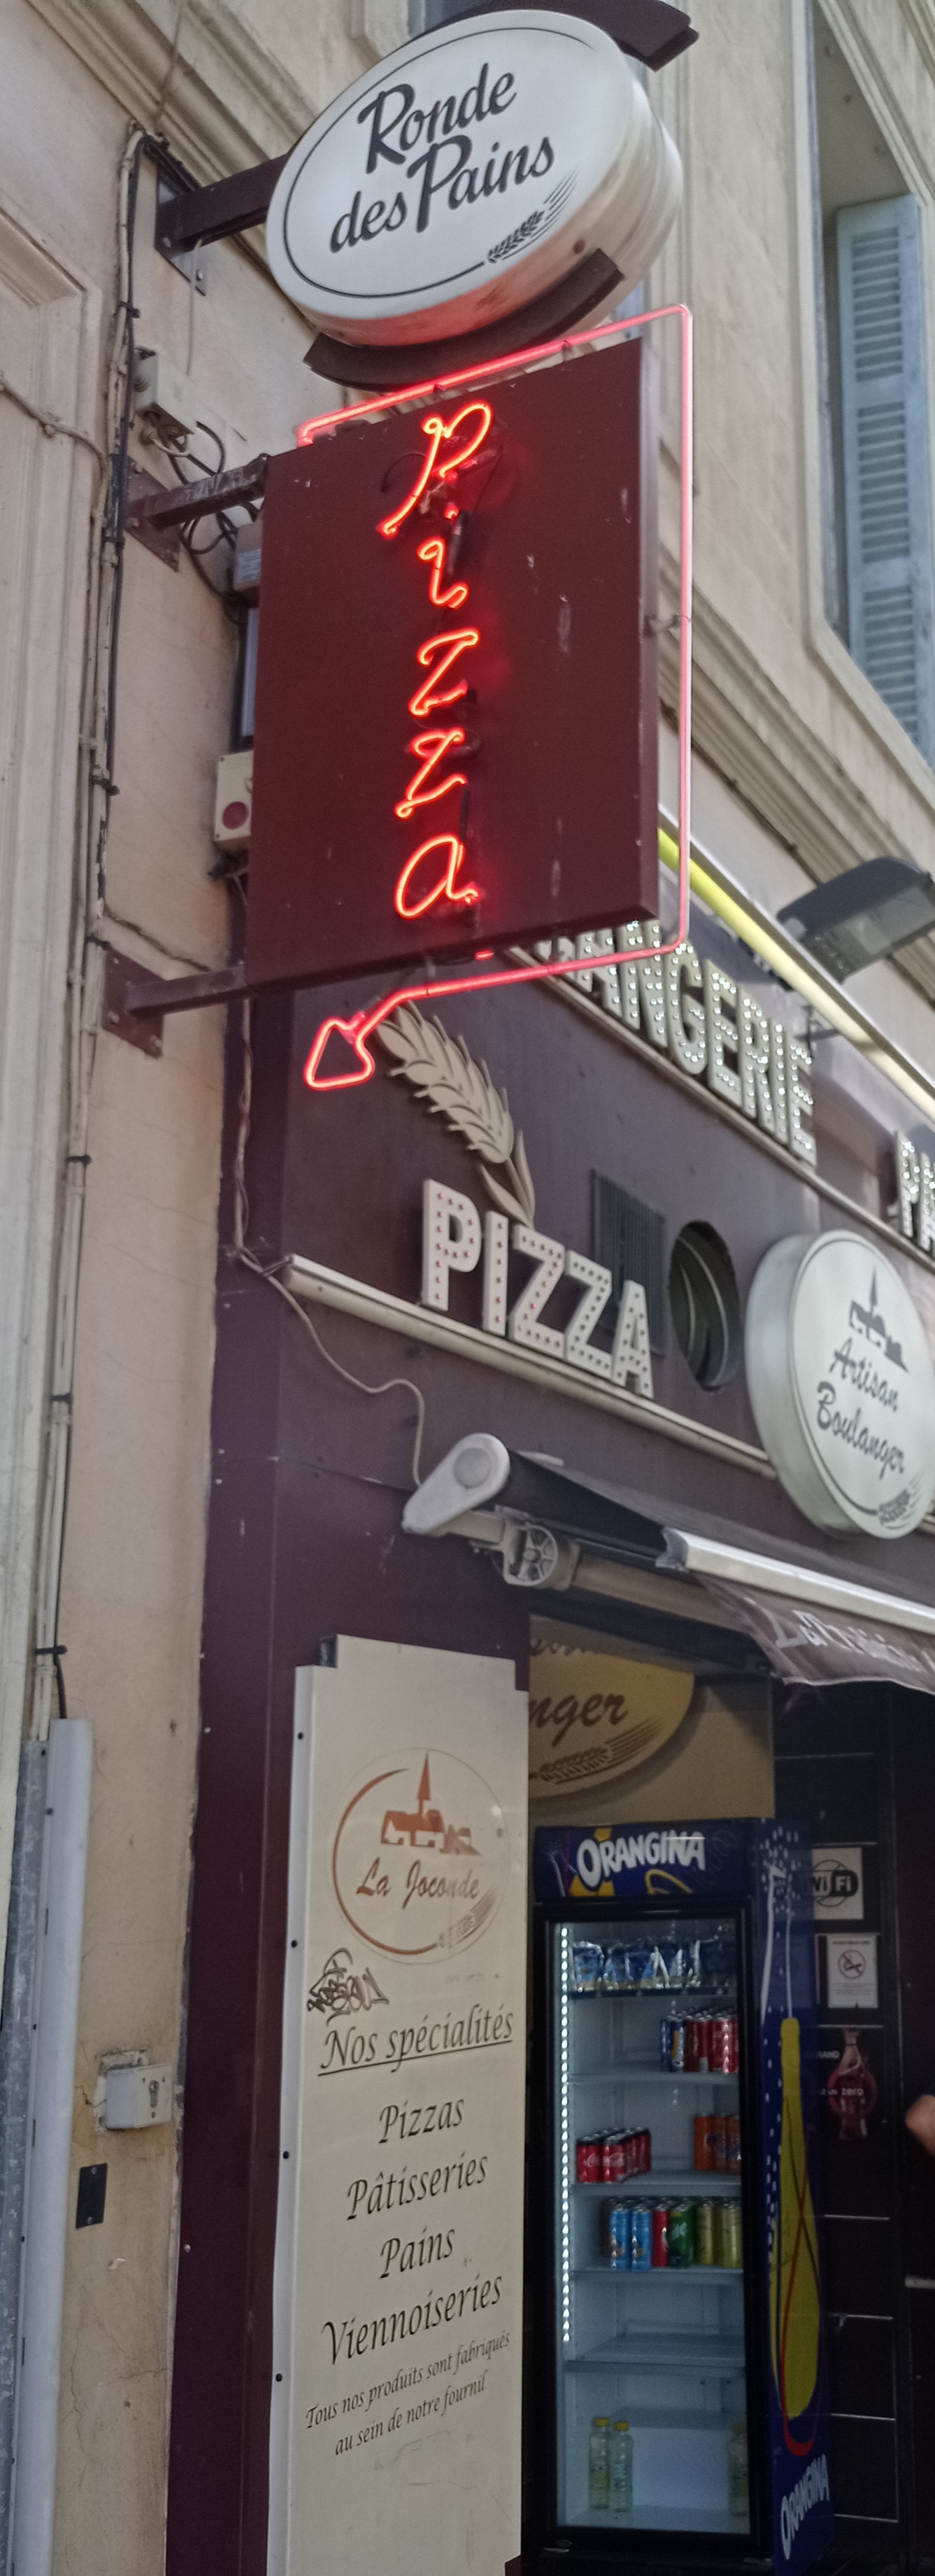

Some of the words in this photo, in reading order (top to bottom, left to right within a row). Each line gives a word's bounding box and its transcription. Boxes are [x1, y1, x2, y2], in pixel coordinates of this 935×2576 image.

[357, 63, 518, 174] Ronde
[329, 190, 407, 253] des
[406, 135, 554, 233] Pains
[378, 401, 480, 918] Pizza
[535, 919, 817, 1167] ANGERIE
[422, 1179, 654, 1398] PIZZA
[829, 1337, 899, 1412] Artisan
[817, 1381, 904, 1480] Boulanger
[357, 1857, 392, 1897] La
[403, 1860, 480, 1909] Joconde
[576, 1829, 706, 1889] ORANGINA
[321, 2025, 377, 2069] Nos
[386, 2004, 514, 2072] spécialités
[379, 2098, 465, 2144] Pizzas
[347, 2151, 488, 2221] Pâtisseries
[380, 2225, 455, 2279] Pains
[322, 2272, 503, 2365] Viennoiseries
[306, 2402, 338, 2428] Tous
[342, 2391, 365, 2414] nos
[364, 2368, 424, 2412] produits
[426, 2353, 452, 2379] sont
[452, 2331, 511, 2375] fabriqués
[335, 2433, 353, 2456] au
[357, 2420, 384, 2446] sein
[387, 2407, 403, 2433] de
[406, 2395, 441, 2424] notre
[441, 2370, 488, 2416] fournil
[780, 2454, 830, 2561] ORANGINA
